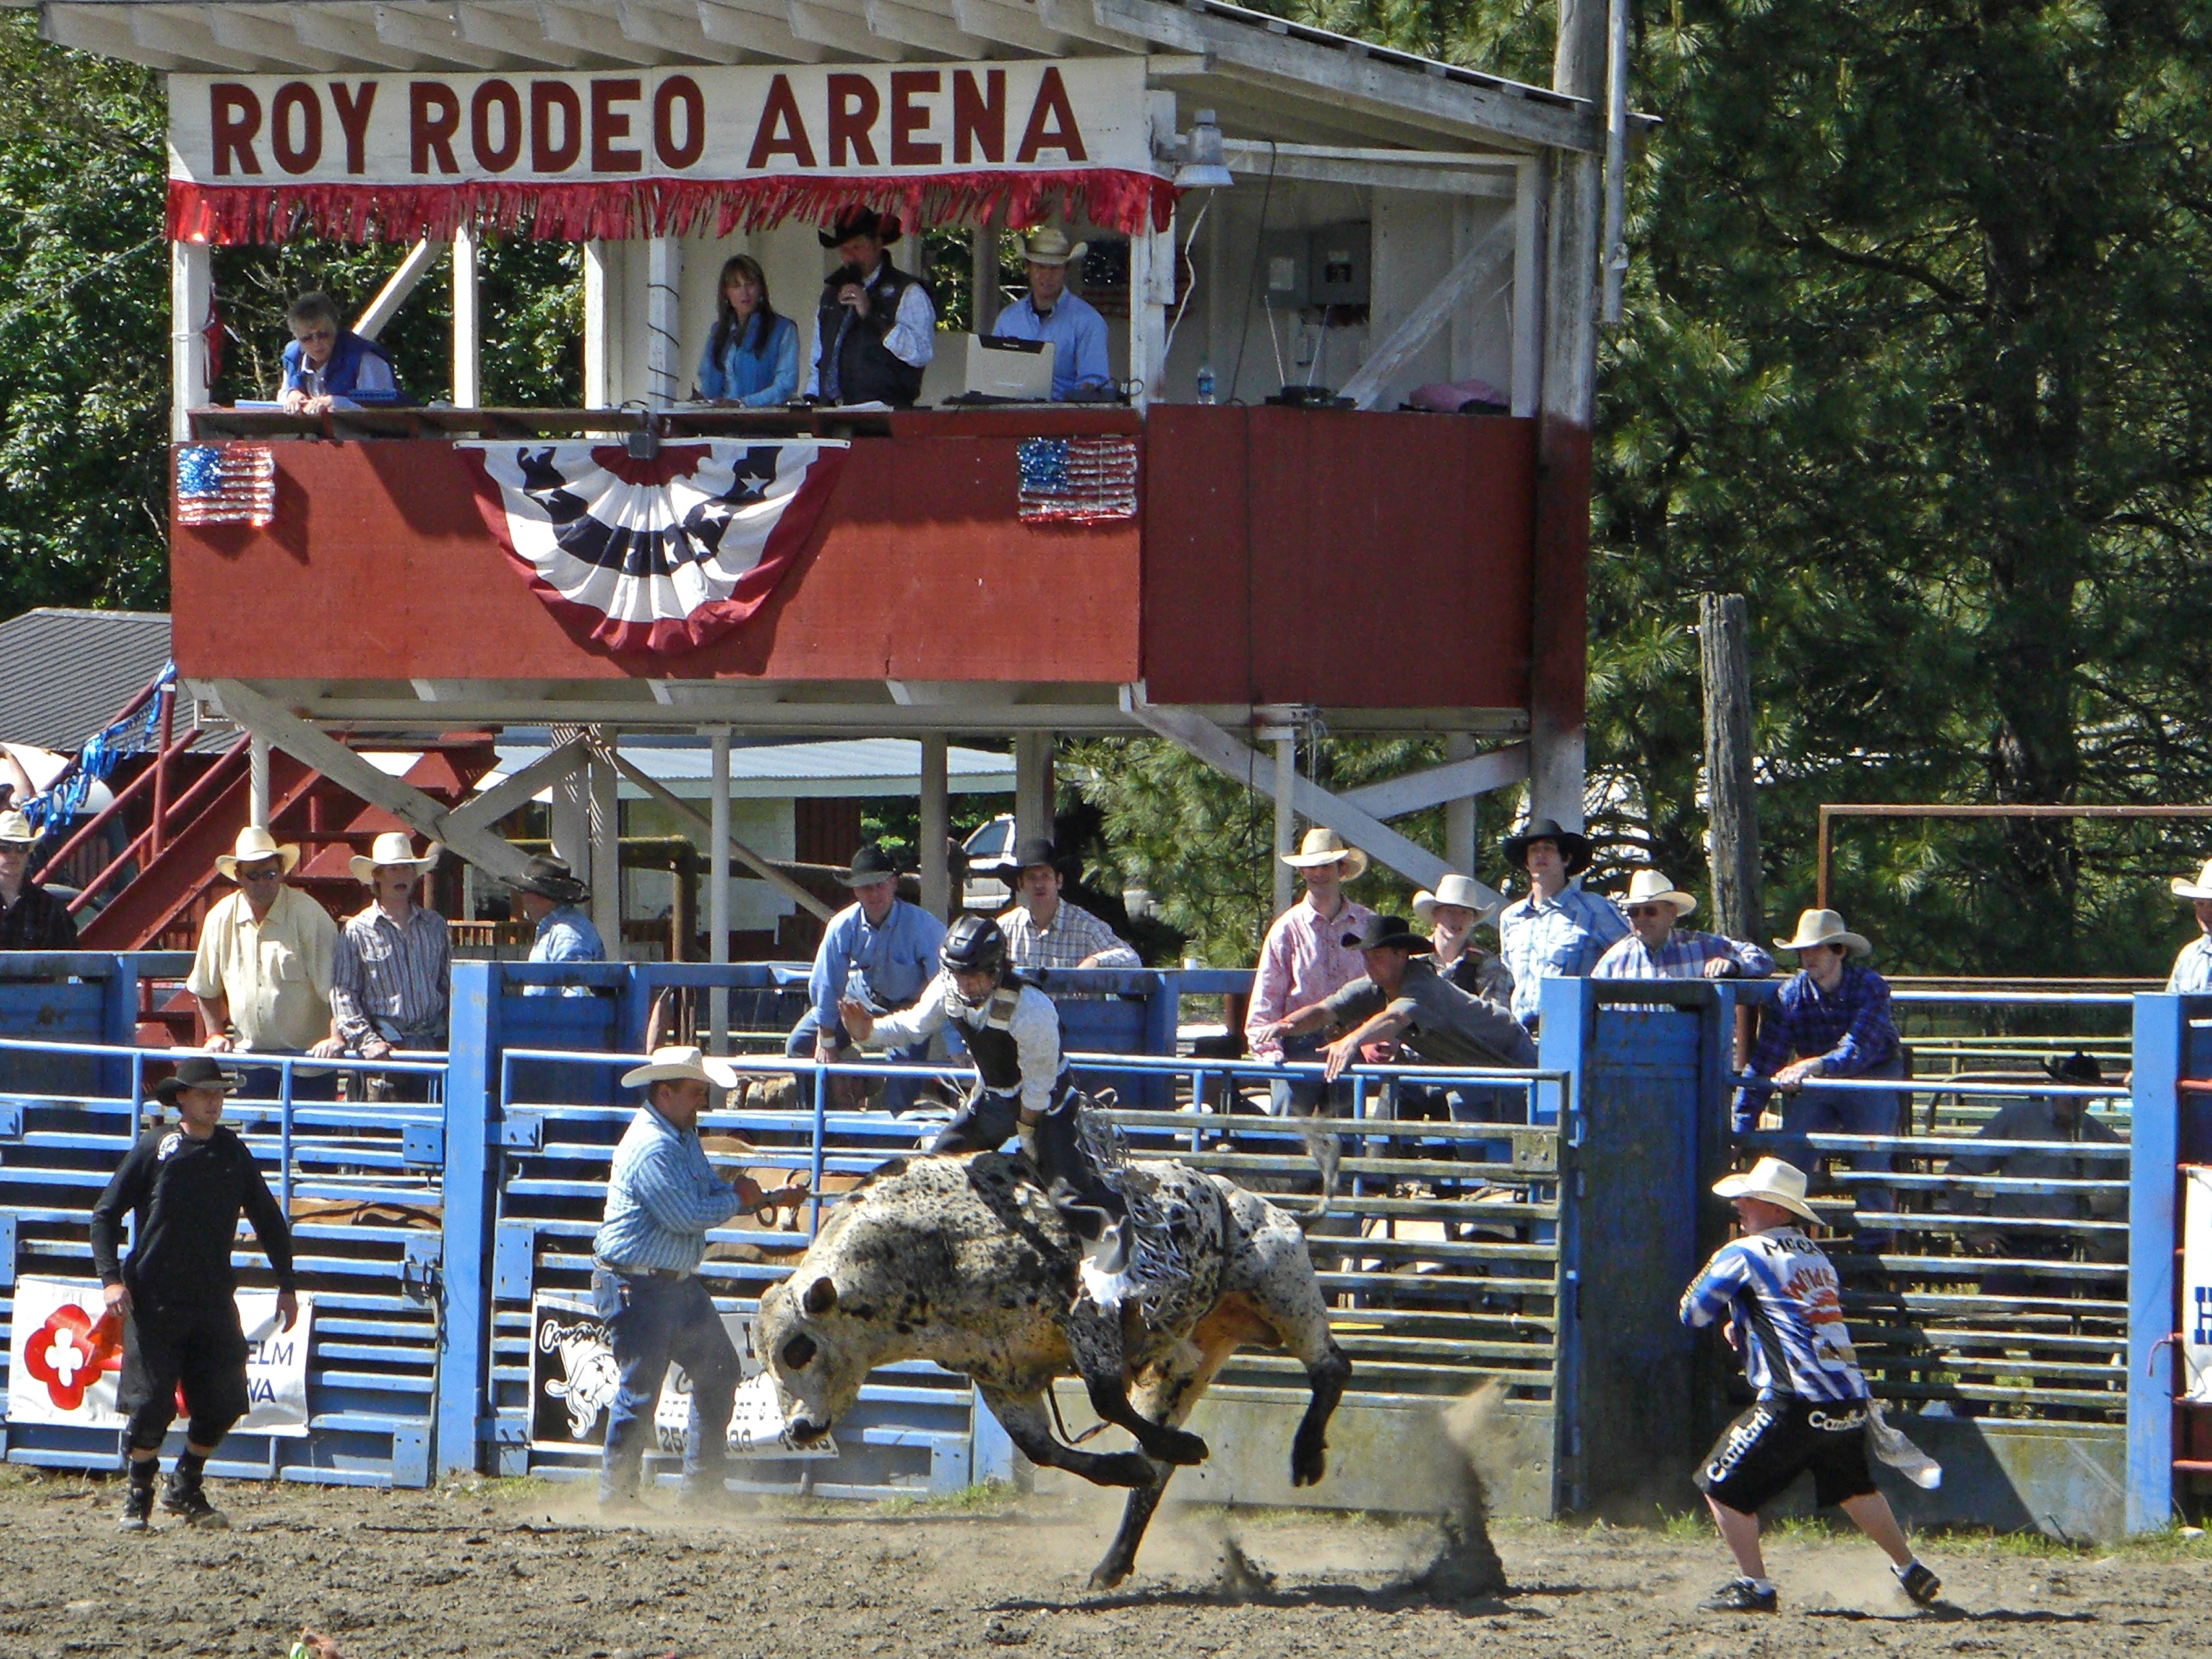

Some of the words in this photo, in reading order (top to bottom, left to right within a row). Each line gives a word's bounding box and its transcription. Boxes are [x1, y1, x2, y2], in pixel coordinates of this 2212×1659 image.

[209, 81, 377, 176] ROY
[409, 74, 705, 174] RODEO
[746, 66, 1088, 169] ARENA
[245, 1340, 294, 1366] ELM
